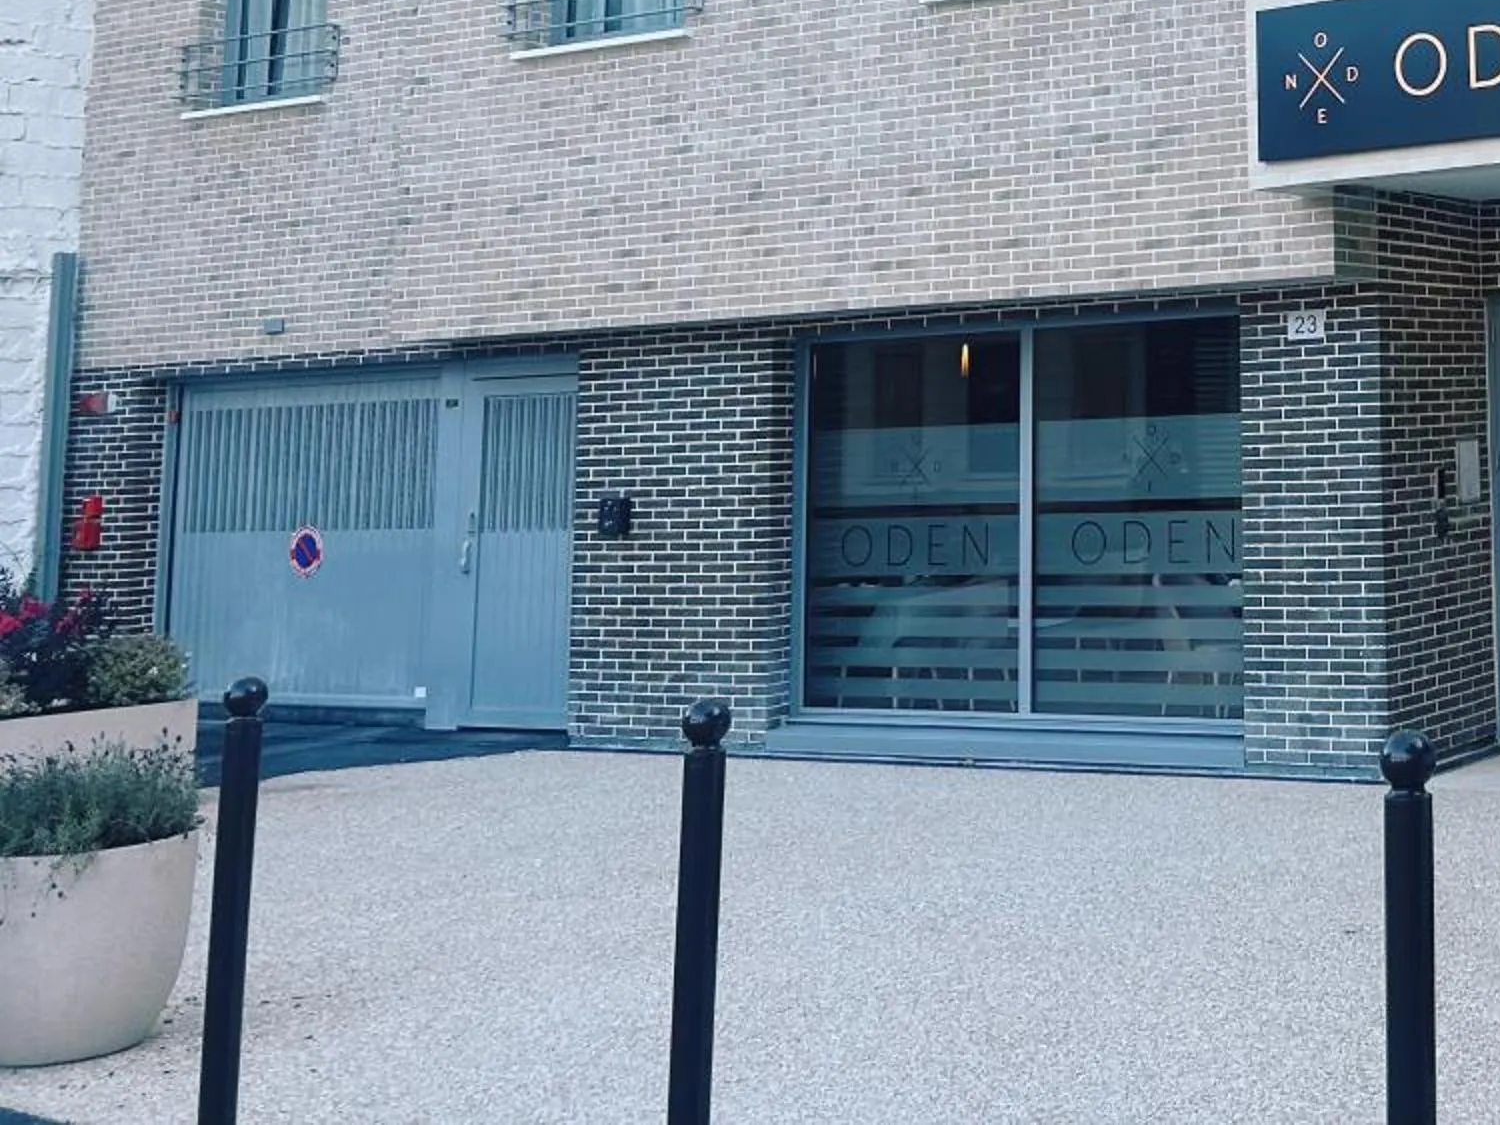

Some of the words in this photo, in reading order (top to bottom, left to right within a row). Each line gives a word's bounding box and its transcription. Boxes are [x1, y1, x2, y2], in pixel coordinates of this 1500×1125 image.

[1313, 32, 1328, 48] O
[1285, 74, 1298, 90] N
[1346, 66, 1359, 82] D
[1316, 108, 1328, 124] E
[1294, 314, 1318, 334] 23
[841, 523, 989, 567] ODEN
[1071, 518, 1236, 565] ODEN
